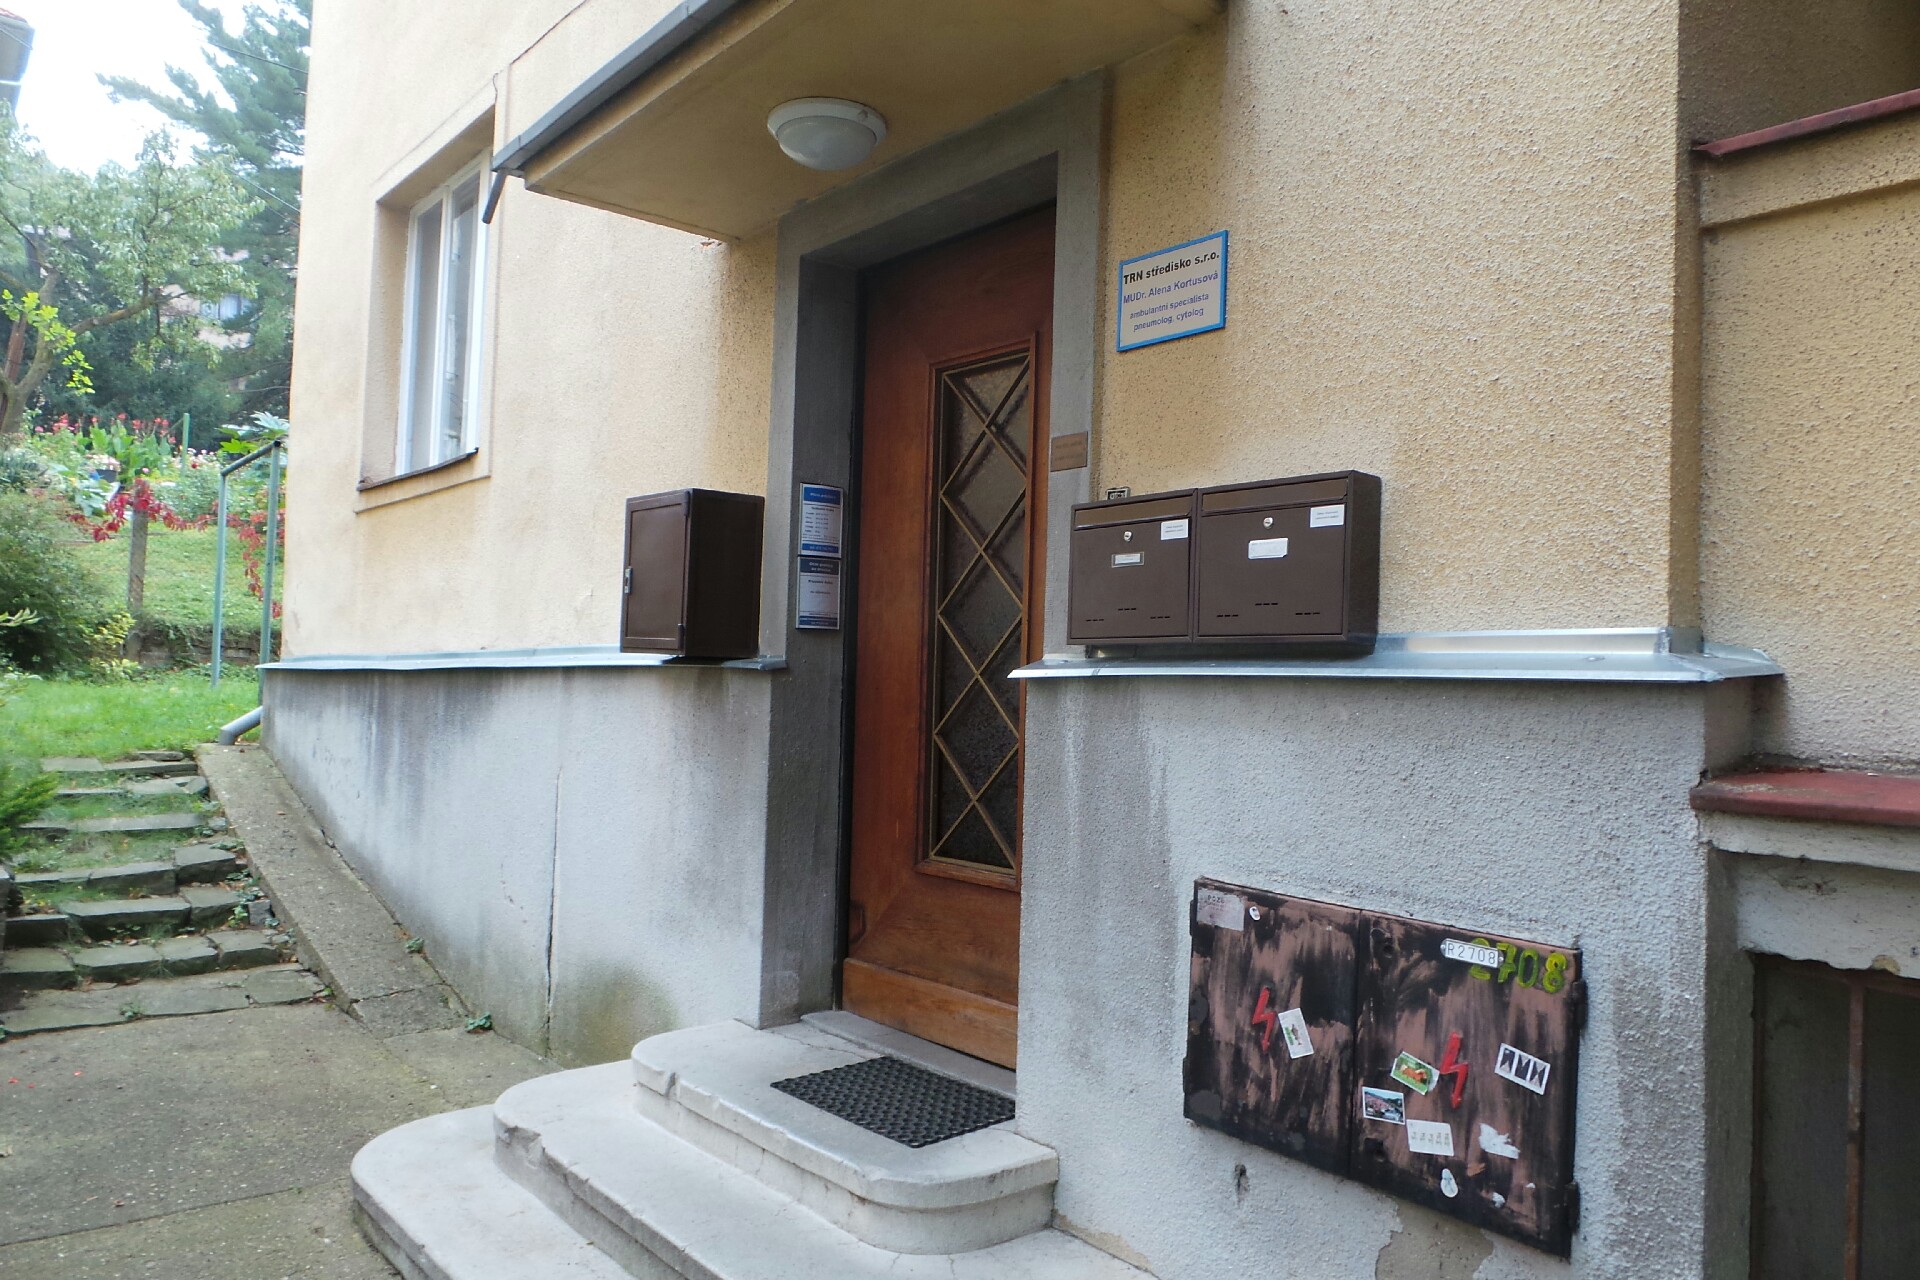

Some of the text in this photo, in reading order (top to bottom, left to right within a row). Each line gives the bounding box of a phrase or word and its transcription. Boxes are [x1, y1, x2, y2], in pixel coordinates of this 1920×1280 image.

[1123, 251, 1220, 285] TRN středisko s.r.o.
[1123, 270, 1219, 304] MUDr. Alena Kortusová
[1169, 293, 1209, 311] specialista
[1176, 307, 1204, 322] cytolog
[1446, 942, 1497, 966] R2708
